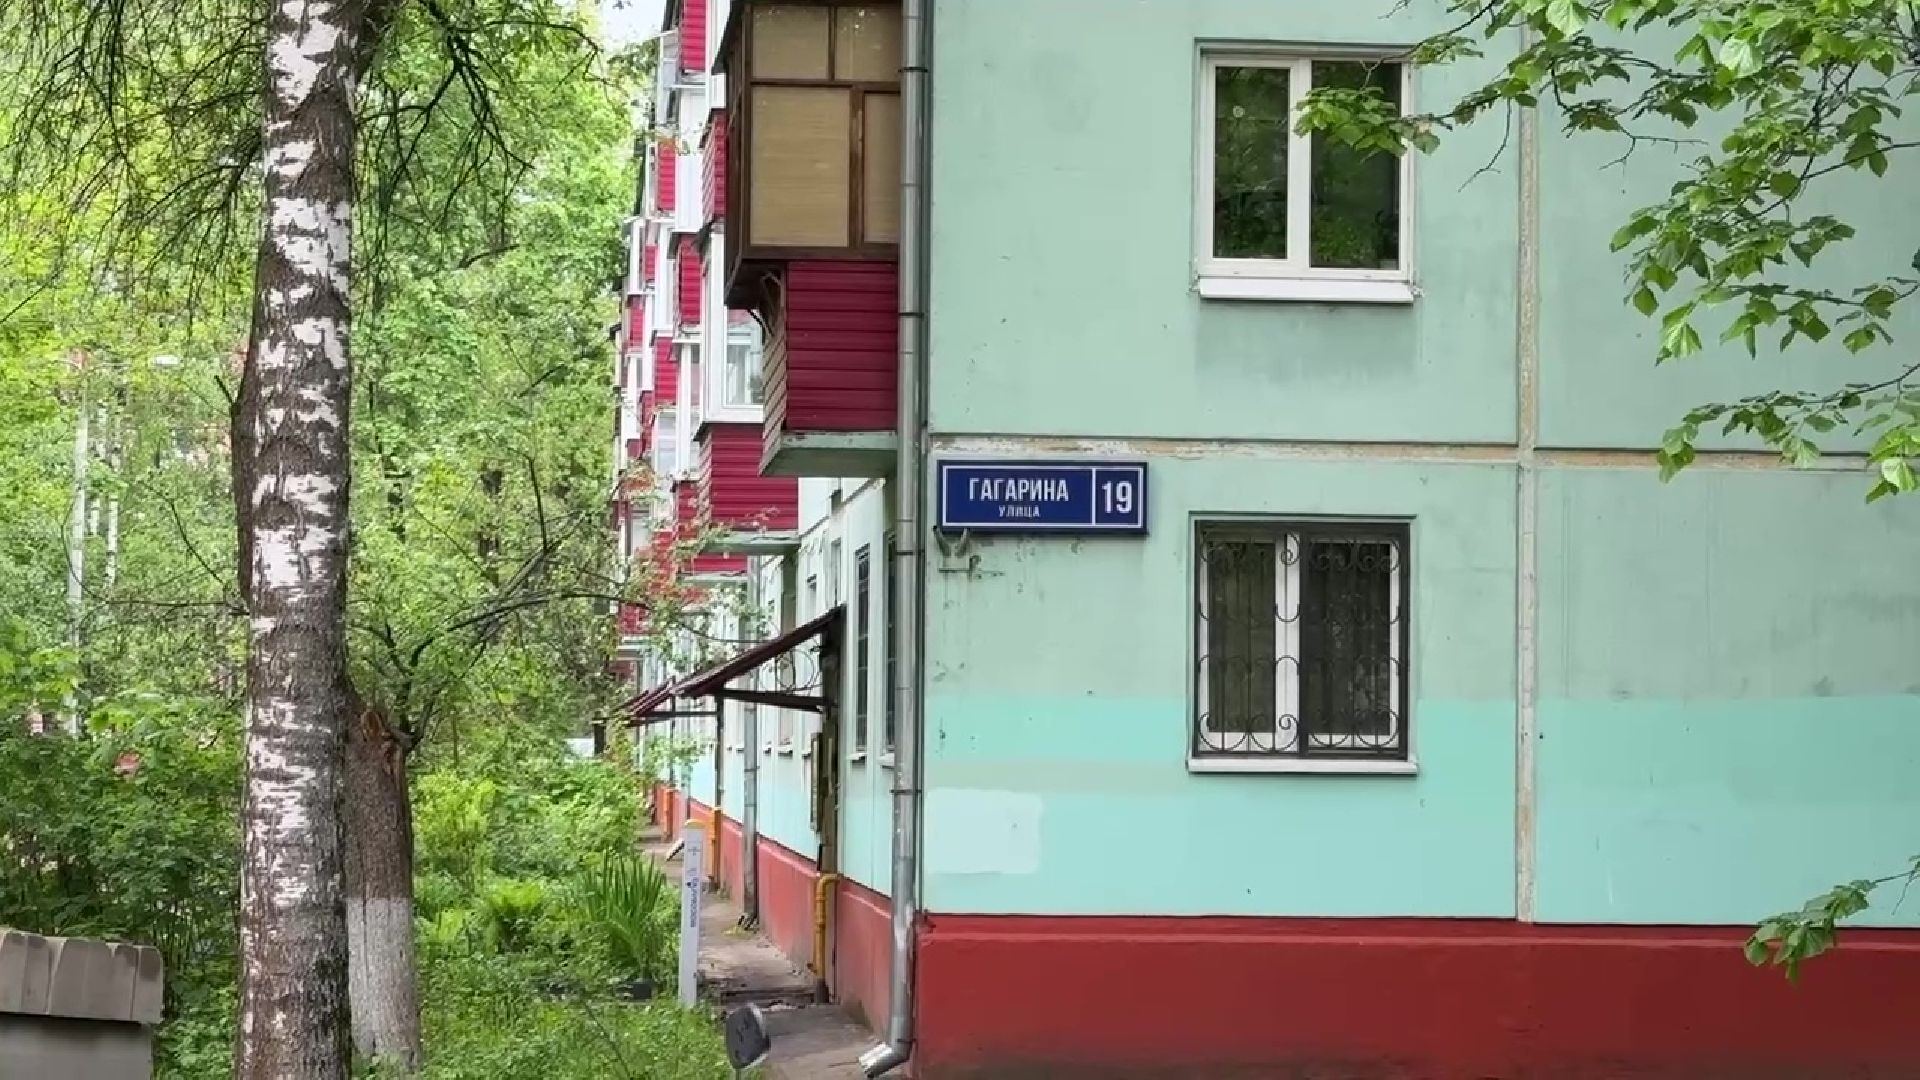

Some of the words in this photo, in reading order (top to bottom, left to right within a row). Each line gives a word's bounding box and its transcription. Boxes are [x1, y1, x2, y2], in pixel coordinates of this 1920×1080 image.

[968, 477, 1069, 501] ГАГАРИНА
[1101, 480, 1133, 514] 19
[998, 504, 1040, 518] УЛИЦА
